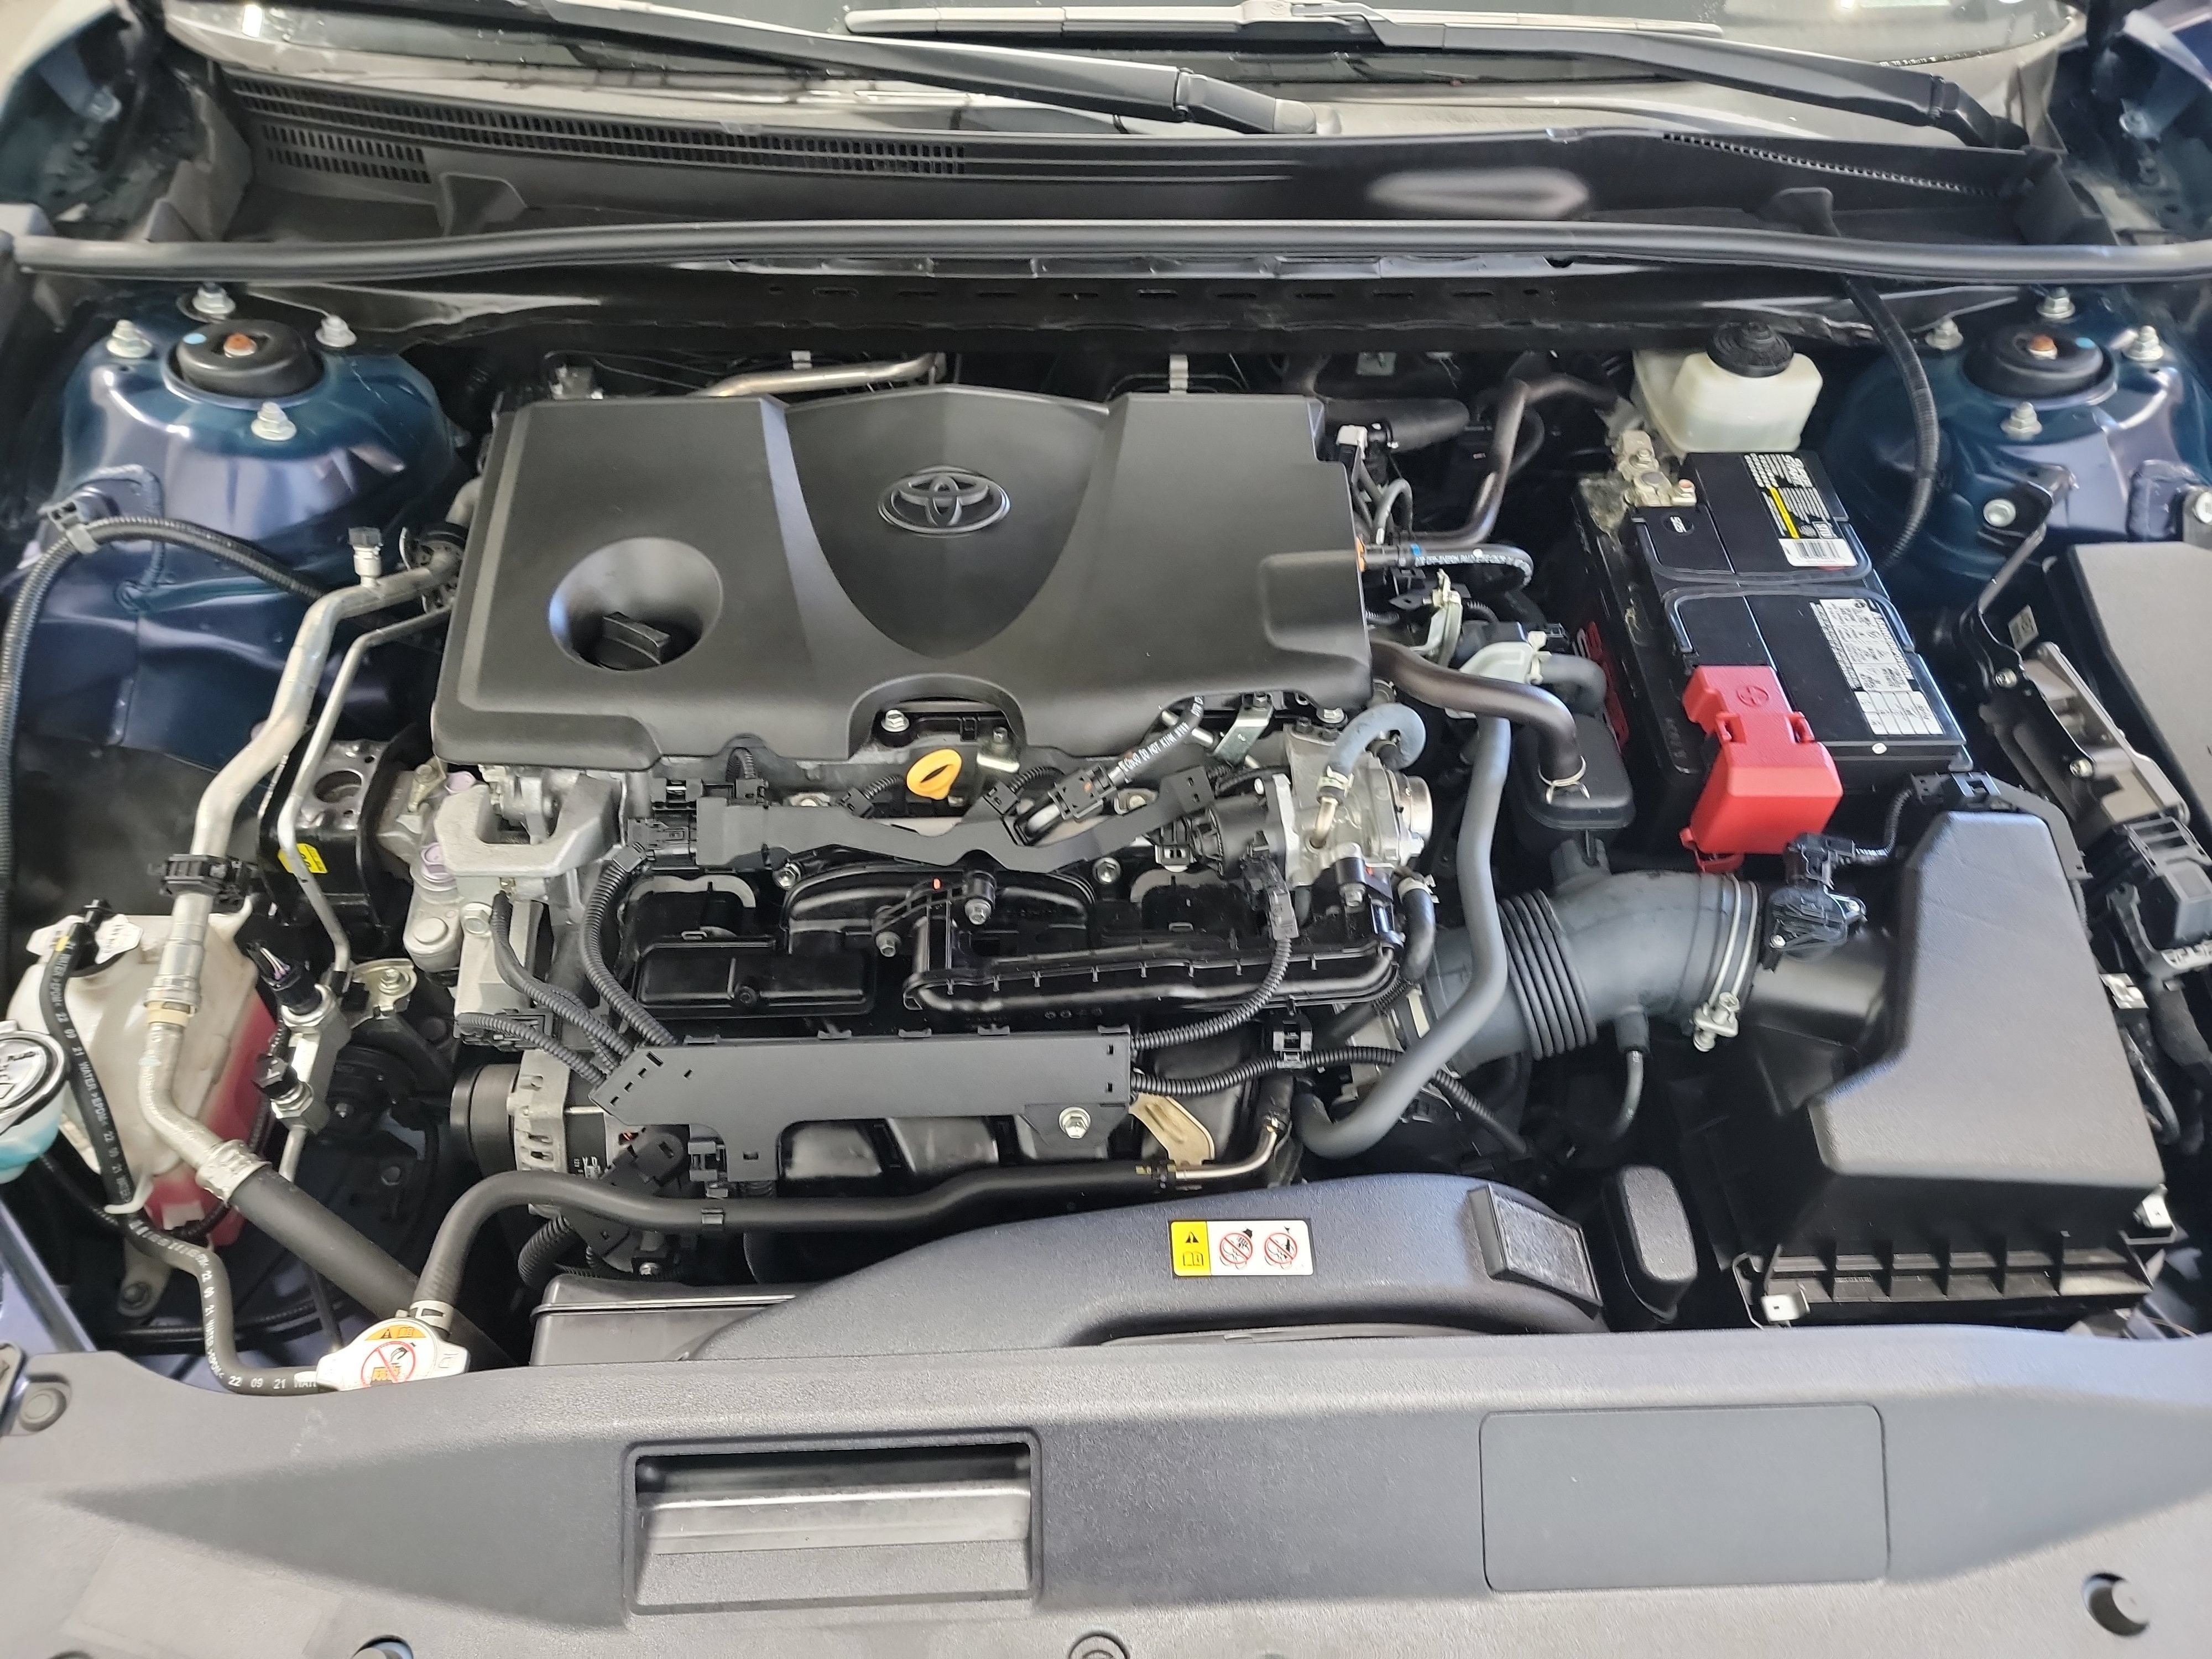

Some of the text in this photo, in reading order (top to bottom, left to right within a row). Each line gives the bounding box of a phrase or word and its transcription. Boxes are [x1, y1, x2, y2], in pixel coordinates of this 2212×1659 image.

[55, 1012, 70, 1023] 22
[71, 1046, 85, 1056] 21
[78, 1061, 97, 1091] WATER
[103, 1130, 115, 1142] 22
[201, 1271, 213, 1283] 22
[205, 1305, 215, 1317] 21
[228, 1375, 243, 1387] 22
[250, 1378, 264, 1388] 09
[273, 1378, 286, 1390] 21
